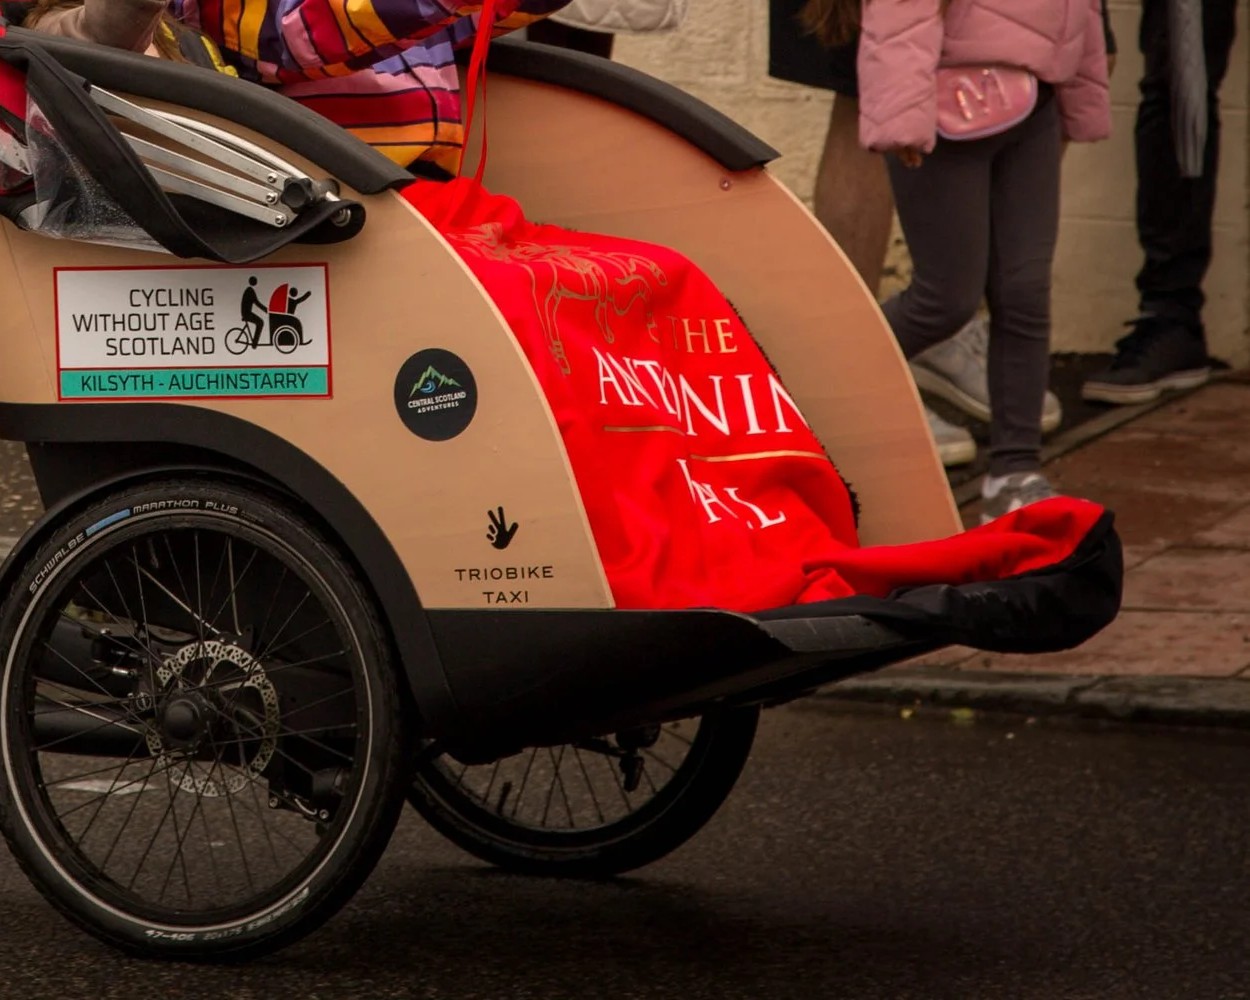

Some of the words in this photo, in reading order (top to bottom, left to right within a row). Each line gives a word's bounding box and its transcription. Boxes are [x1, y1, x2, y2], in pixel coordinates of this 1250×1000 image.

[129, 288, 214, 307] CYCLING
[72, 313, 170, 333] WITHOUT
[174, 312, 215, 331] AGE
[665, 315, 738, 354] THE
[105, 336, 215, 356] SCOTLAND
[80, 375, 154, 392] KILSYTH
[168, 372, 309, 391] AUCHINSTARRY
[407, 397, 435, 409] CENTRAL
[435, 391, 467, 404] SCOTLAND
[417, 401, 459, 414] ADVENTURES
[28, 532, 85, 595] SCHWALBE
[133, 499, 199, 515] MARATHON
[205, 501, 239, 515] PLUS
[454, 565, 554, 581] TRIOBIKE
[482, 590, 530, 604] TAXI
